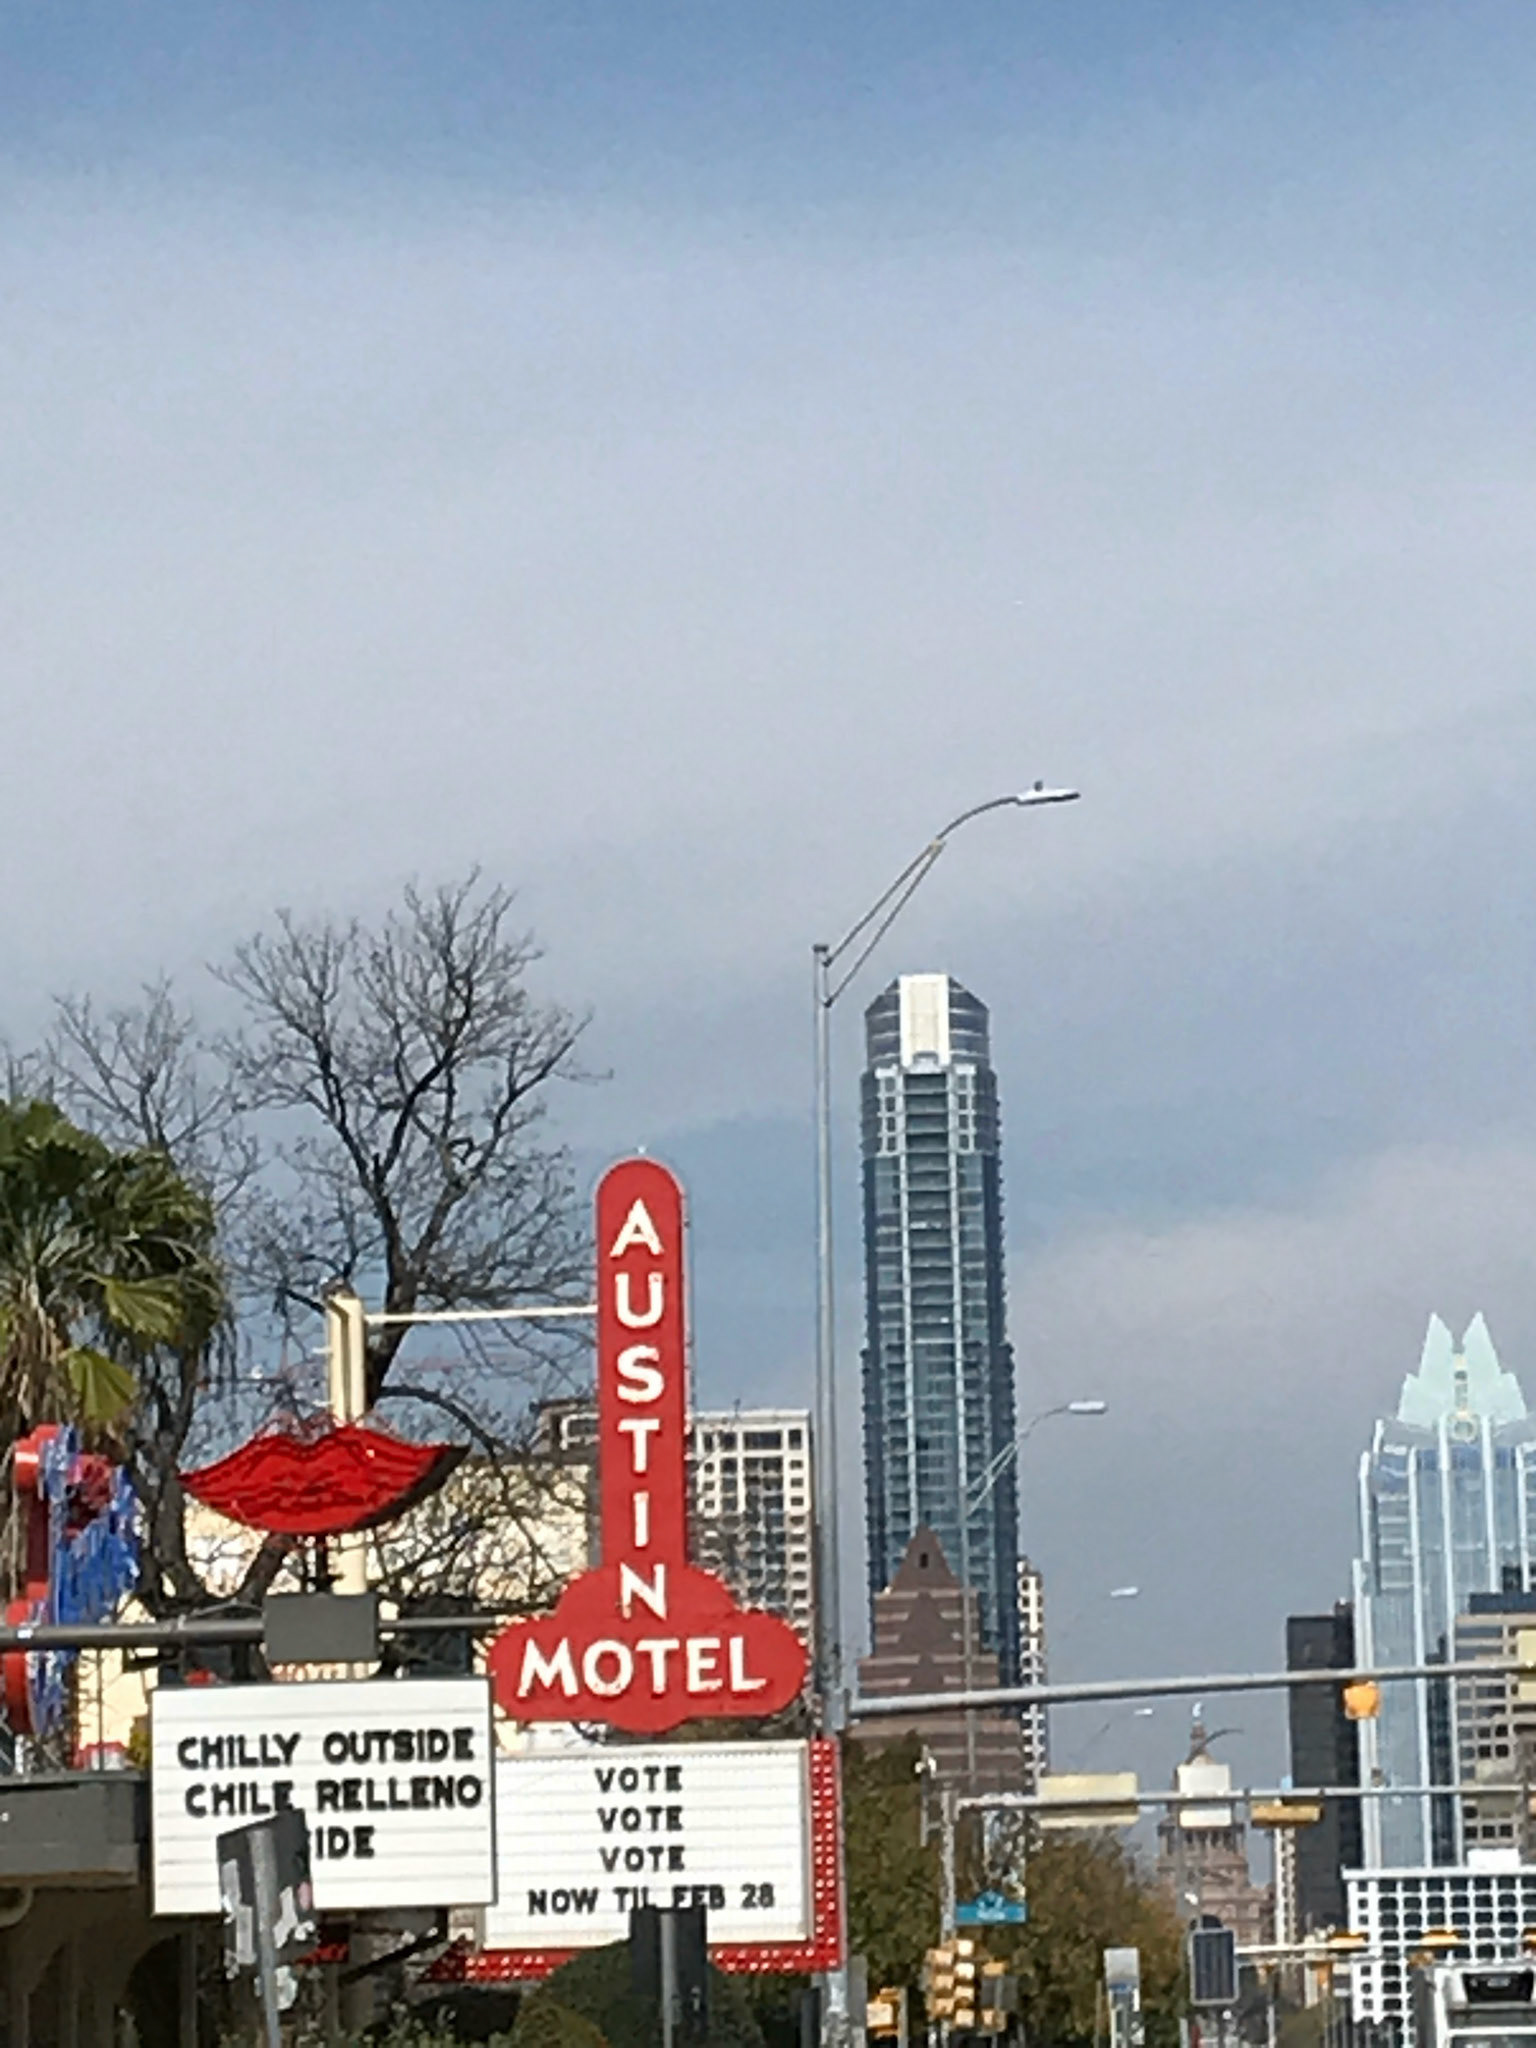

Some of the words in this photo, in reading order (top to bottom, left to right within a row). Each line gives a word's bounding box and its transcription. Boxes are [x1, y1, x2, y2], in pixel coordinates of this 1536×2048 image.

[610, 1198, 667, 1620] AUSTIN
[517, 1635, 767, 1699] MOTEL
[177, 1732, 301, 1770] CHILLY
[323, 1727, 475, 1764] OUTSIDE
[184, 1780, 294, 1818] CHILE
[316, 1774, 482, 1813] RELLENO
[594, 1765, 683, 1793] VOTE
[597, 1805, 683, 1832] VOTE
[305, 1825, 375, 1860] IDE
[598, 1845, 685, 1873] VOTE
[527, 1886, 598, 1915] NOW
[613, 1885, 657, 1913] TIL
[671, 1884, 725, 1910] FEB
[740, 1882, 774, 1909] 28
